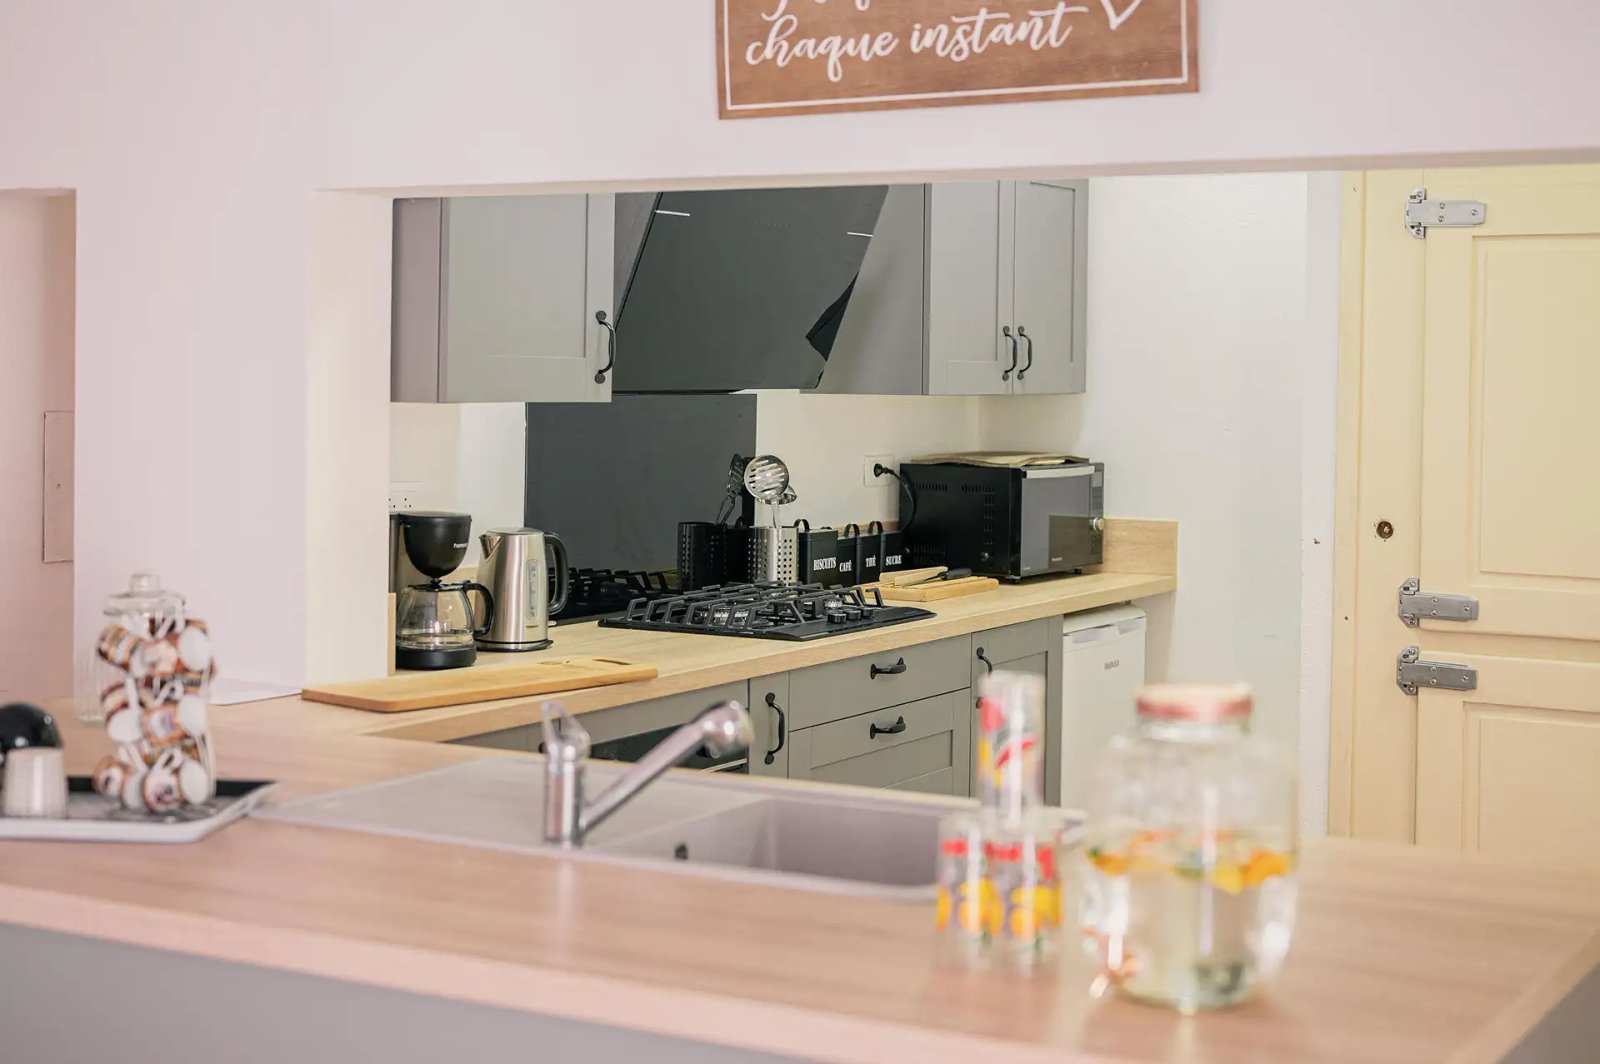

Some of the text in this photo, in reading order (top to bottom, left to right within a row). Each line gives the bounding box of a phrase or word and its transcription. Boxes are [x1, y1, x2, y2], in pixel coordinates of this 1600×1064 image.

[745, 2, 1089, 82] chaque instant
[813, 557, 837, 571] BISCUITS
[839, 560, 852, 573] CAFÉ
[865, 555, 877, 567] THÉ
[885, 555, 902, 566] SUCRE
